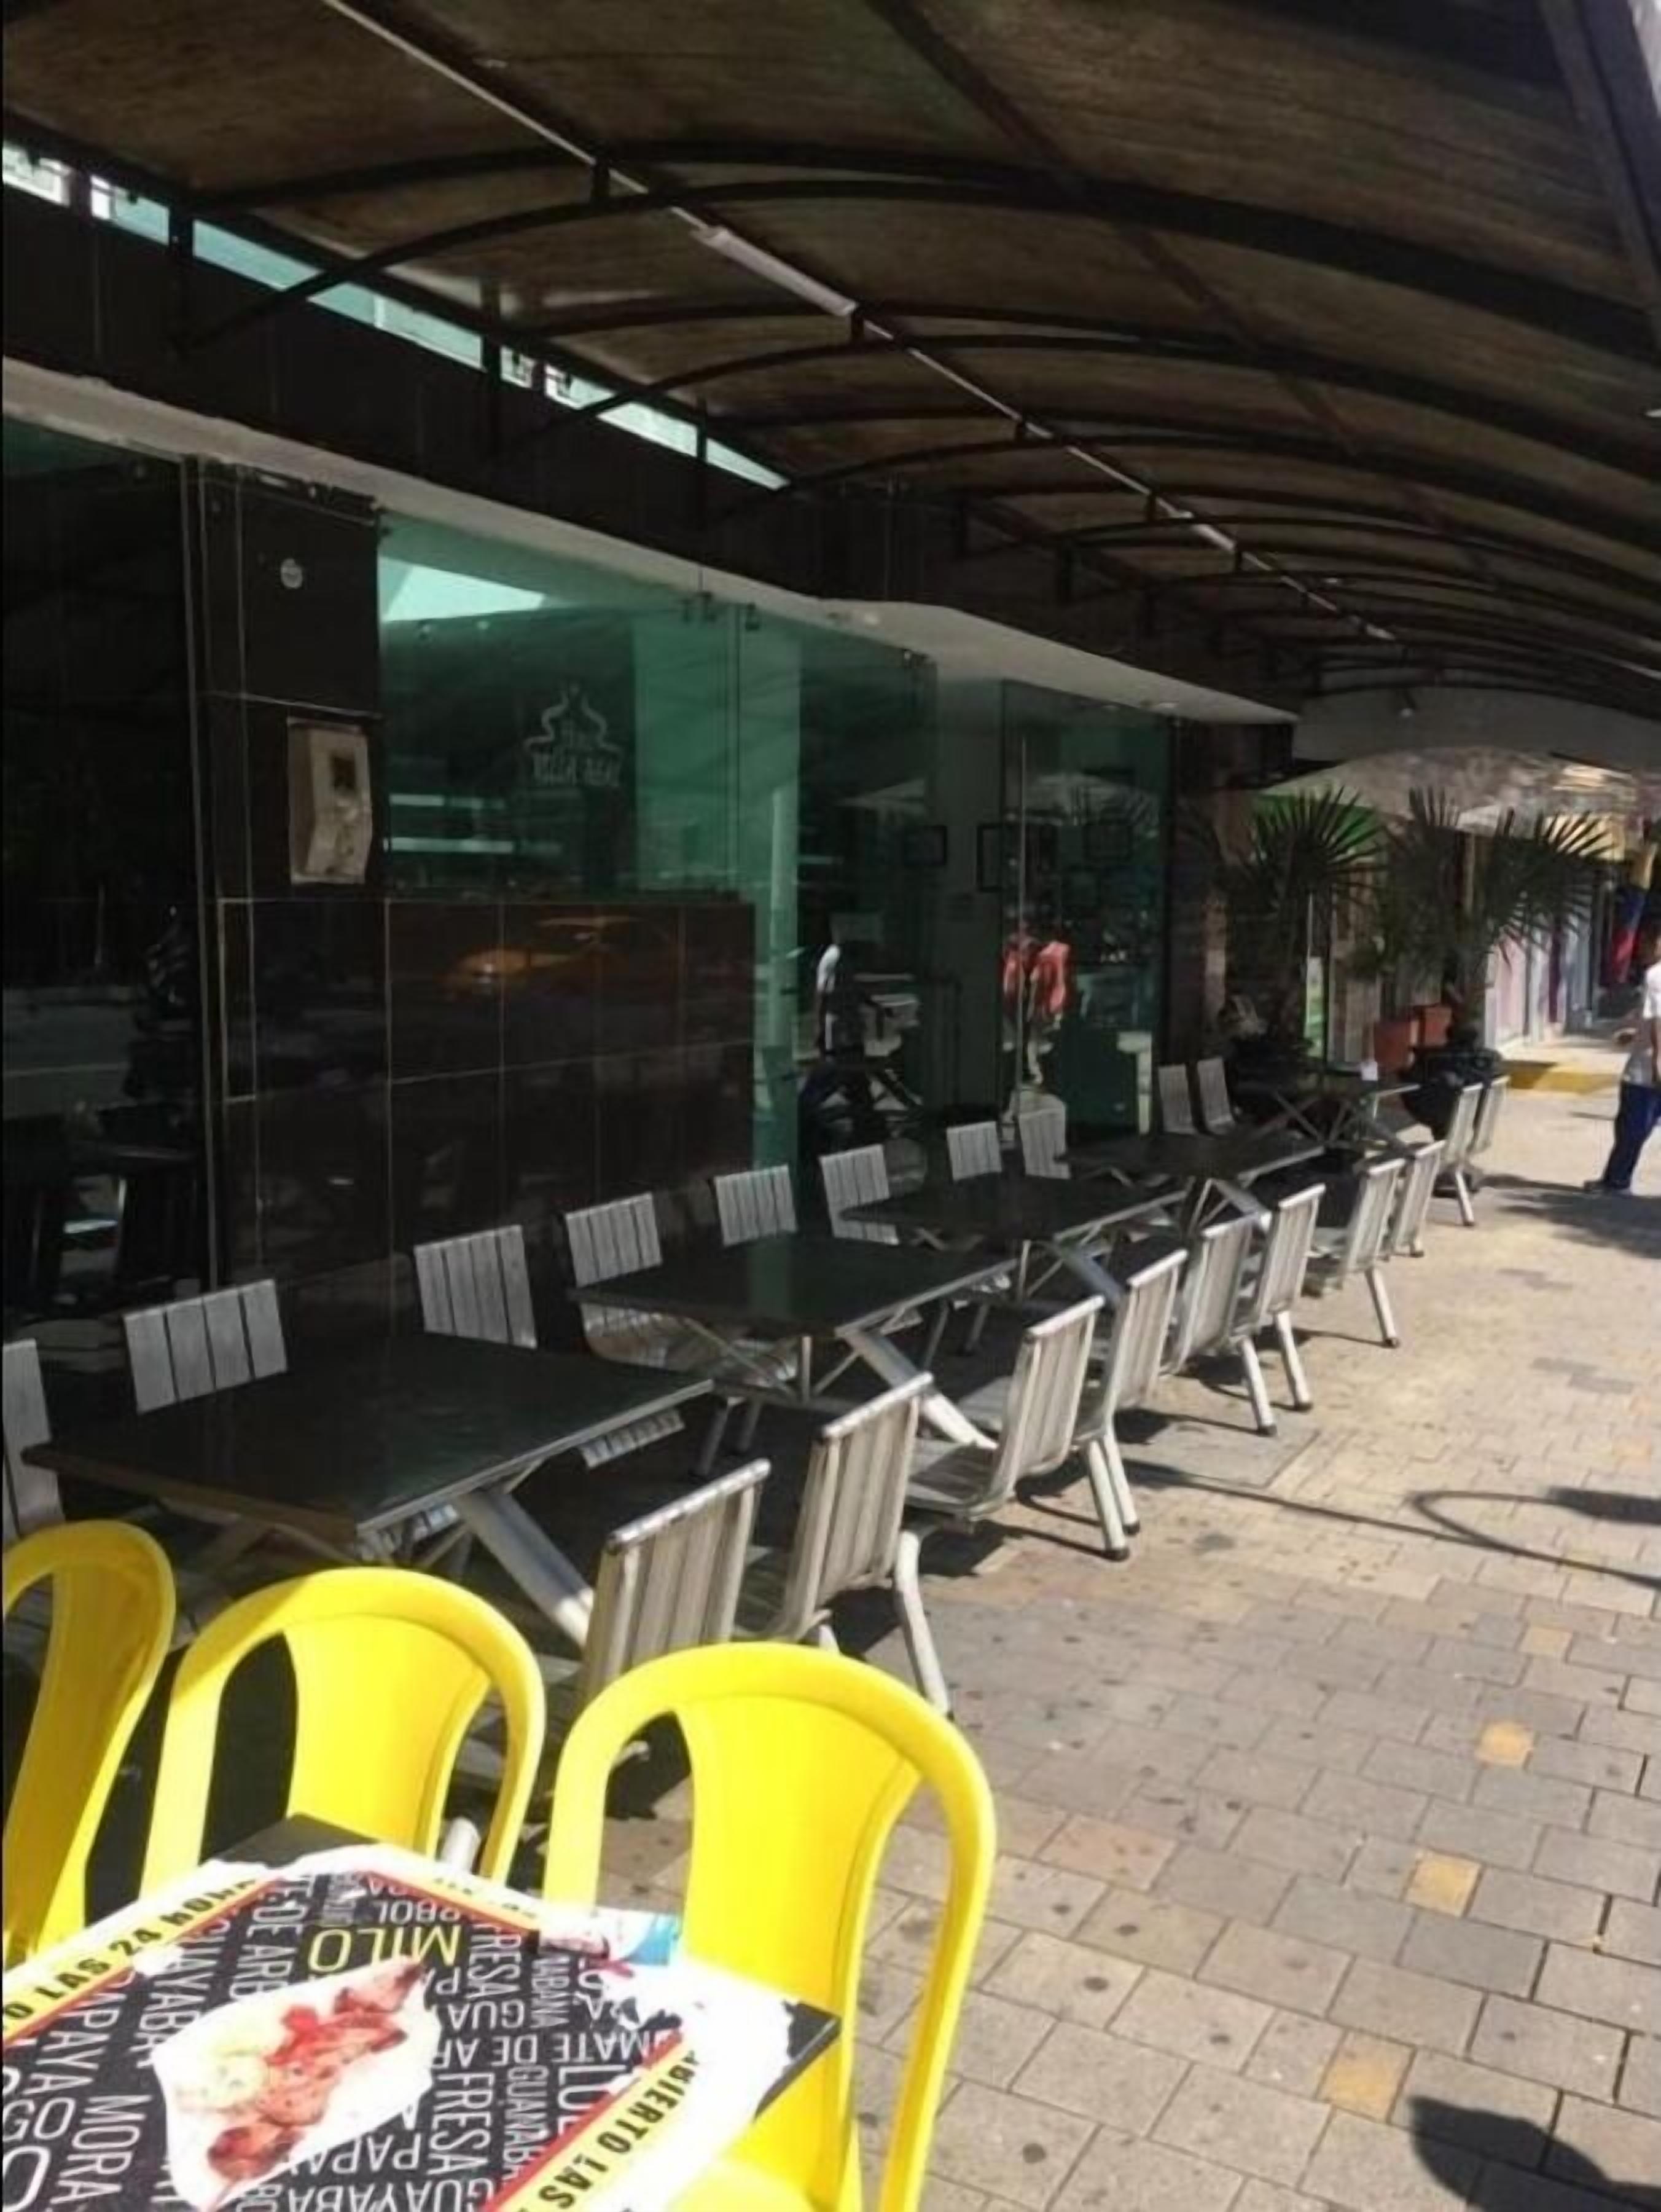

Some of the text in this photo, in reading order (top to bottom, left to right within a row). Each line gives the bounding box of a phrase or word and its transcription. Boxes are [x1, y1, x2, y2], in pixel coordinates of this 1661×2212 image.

[34, 1958, 111, 1999] LAS
[109, 1928, 162, 1956] 24
[160, 1880, 256, 1927] HO
[308, 1924, 462, 1974] MILO
[447, 1999, 525, 2030] GUA
[491, 2035, 538, 2067] DE
[550, 2030, 652, 2063] MATE
[49, 2093, 152, 2205] MORA
[426, 2072, 495, 2176] FRESA
[289, 2132, 421, 2176] PAPA
[538, 2154, 609, 2209] LAS
